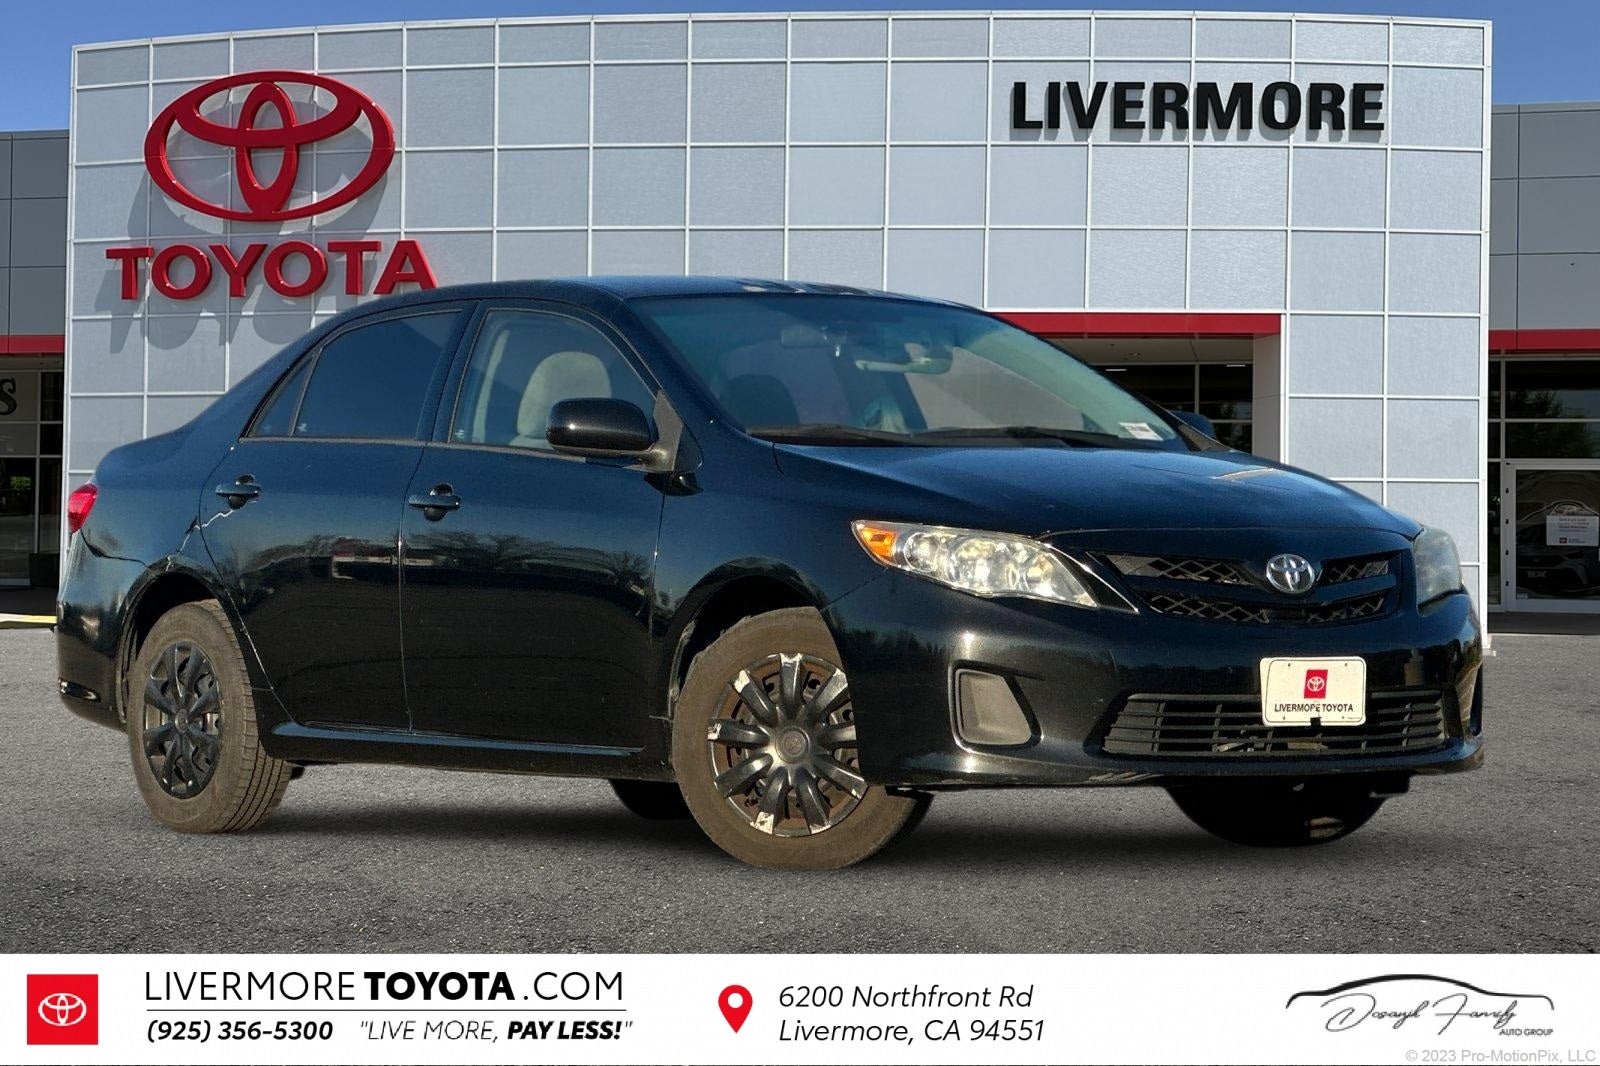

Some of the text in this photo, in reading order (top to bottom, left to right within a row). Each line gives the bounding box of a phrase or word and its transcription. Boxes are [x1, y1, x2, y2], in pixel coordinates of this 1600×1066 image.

[1012, 81, 1385, 131] LIVERMORE
[106, 240, 437, 300] TOYOTA
[1322, 703, 1354, 712] TOYOTA
